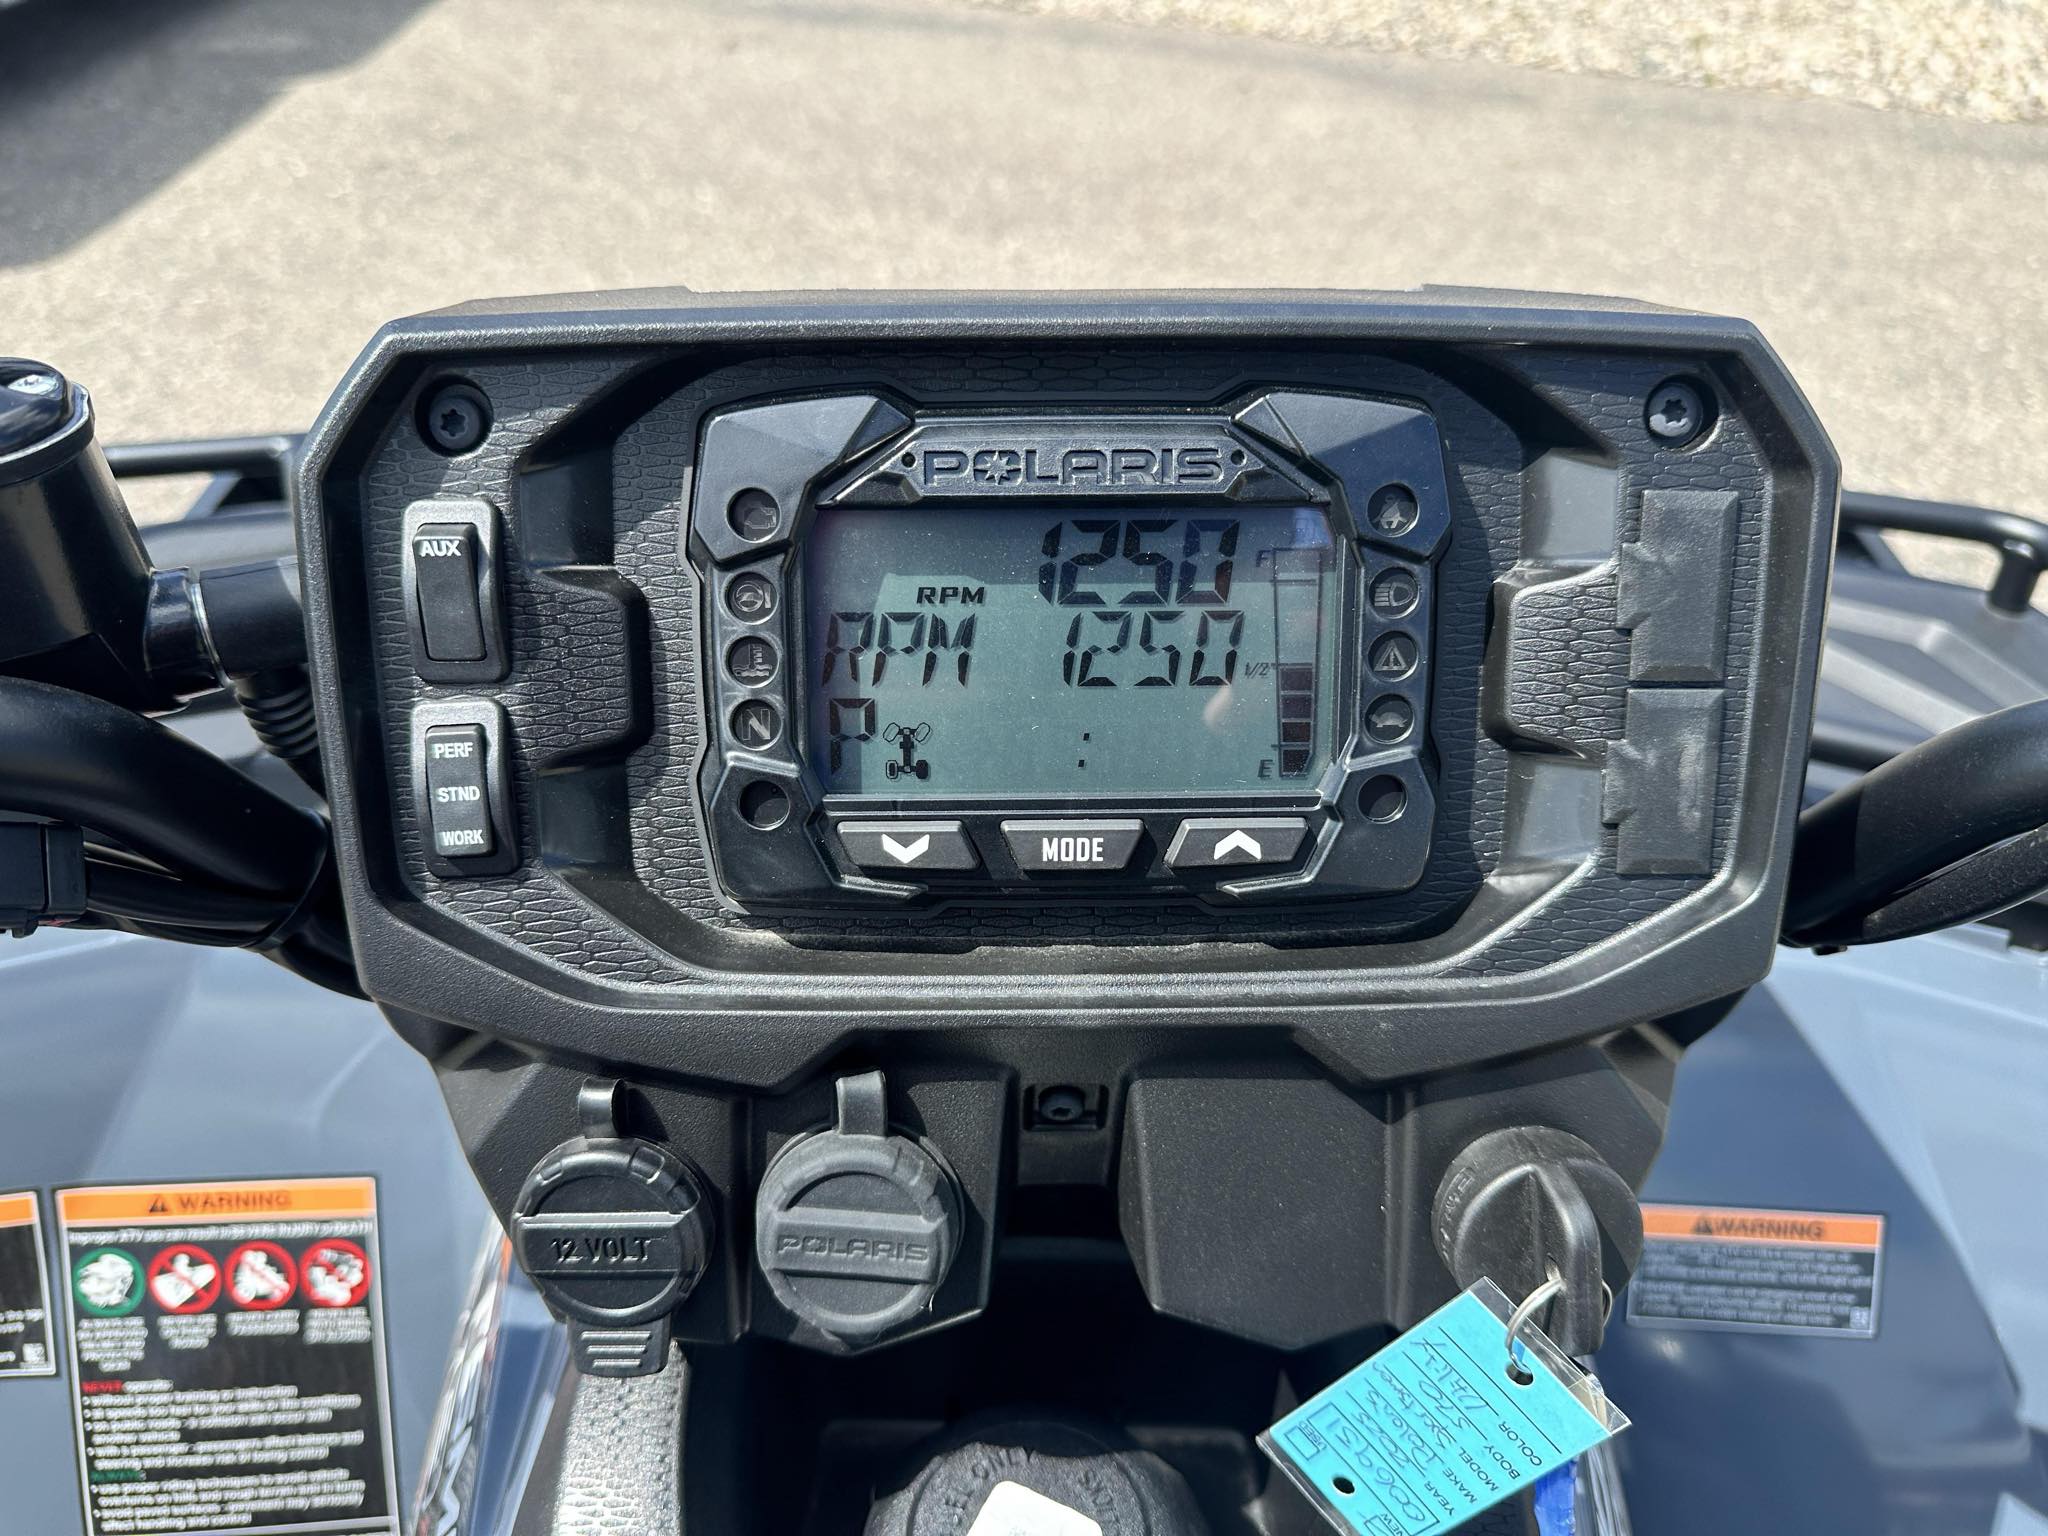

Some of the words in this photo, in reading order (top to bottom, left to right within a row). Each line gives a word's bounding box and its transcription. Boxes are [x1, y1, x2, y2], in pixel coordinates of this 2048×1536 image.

[923, 447, 1225, 487] POLARIS
[419, 539, 462, 558] AUX
[1038, 519, 1240, 606] 1250
[916, 586, 985, 605] RPM
[1062, 609, 1245, 688] 1250
[432, 742, 474, 759] PERF
[829, 697, 876, 775] P
[1257, 758, 1275, 778] E
[437, 786, 481, 802] STND
[442, 829, 485, 846] WORK
[1042, 837, 1105, 864] MODE
[178, 1190, 292, 1210] WARNING
[1712, 1217, 1824, 1240] WARNING
[551, 1237, 580, 1264] 12
[584, 1237, 653, 1263] VOLT
[775, 1234, 930, 1263] POLARIS
[1300, 1422, 1328, 1452] USED
[1498, 1420, 1543, 1467] COLOR
[1458, 1451, 1500, 1492] MODEL
[1483, 1445, 1521, 1480] BODY
[1424, 1480, 1455, 1516] YEAR
[1442, 1469, 1477, 1504] MAKE
